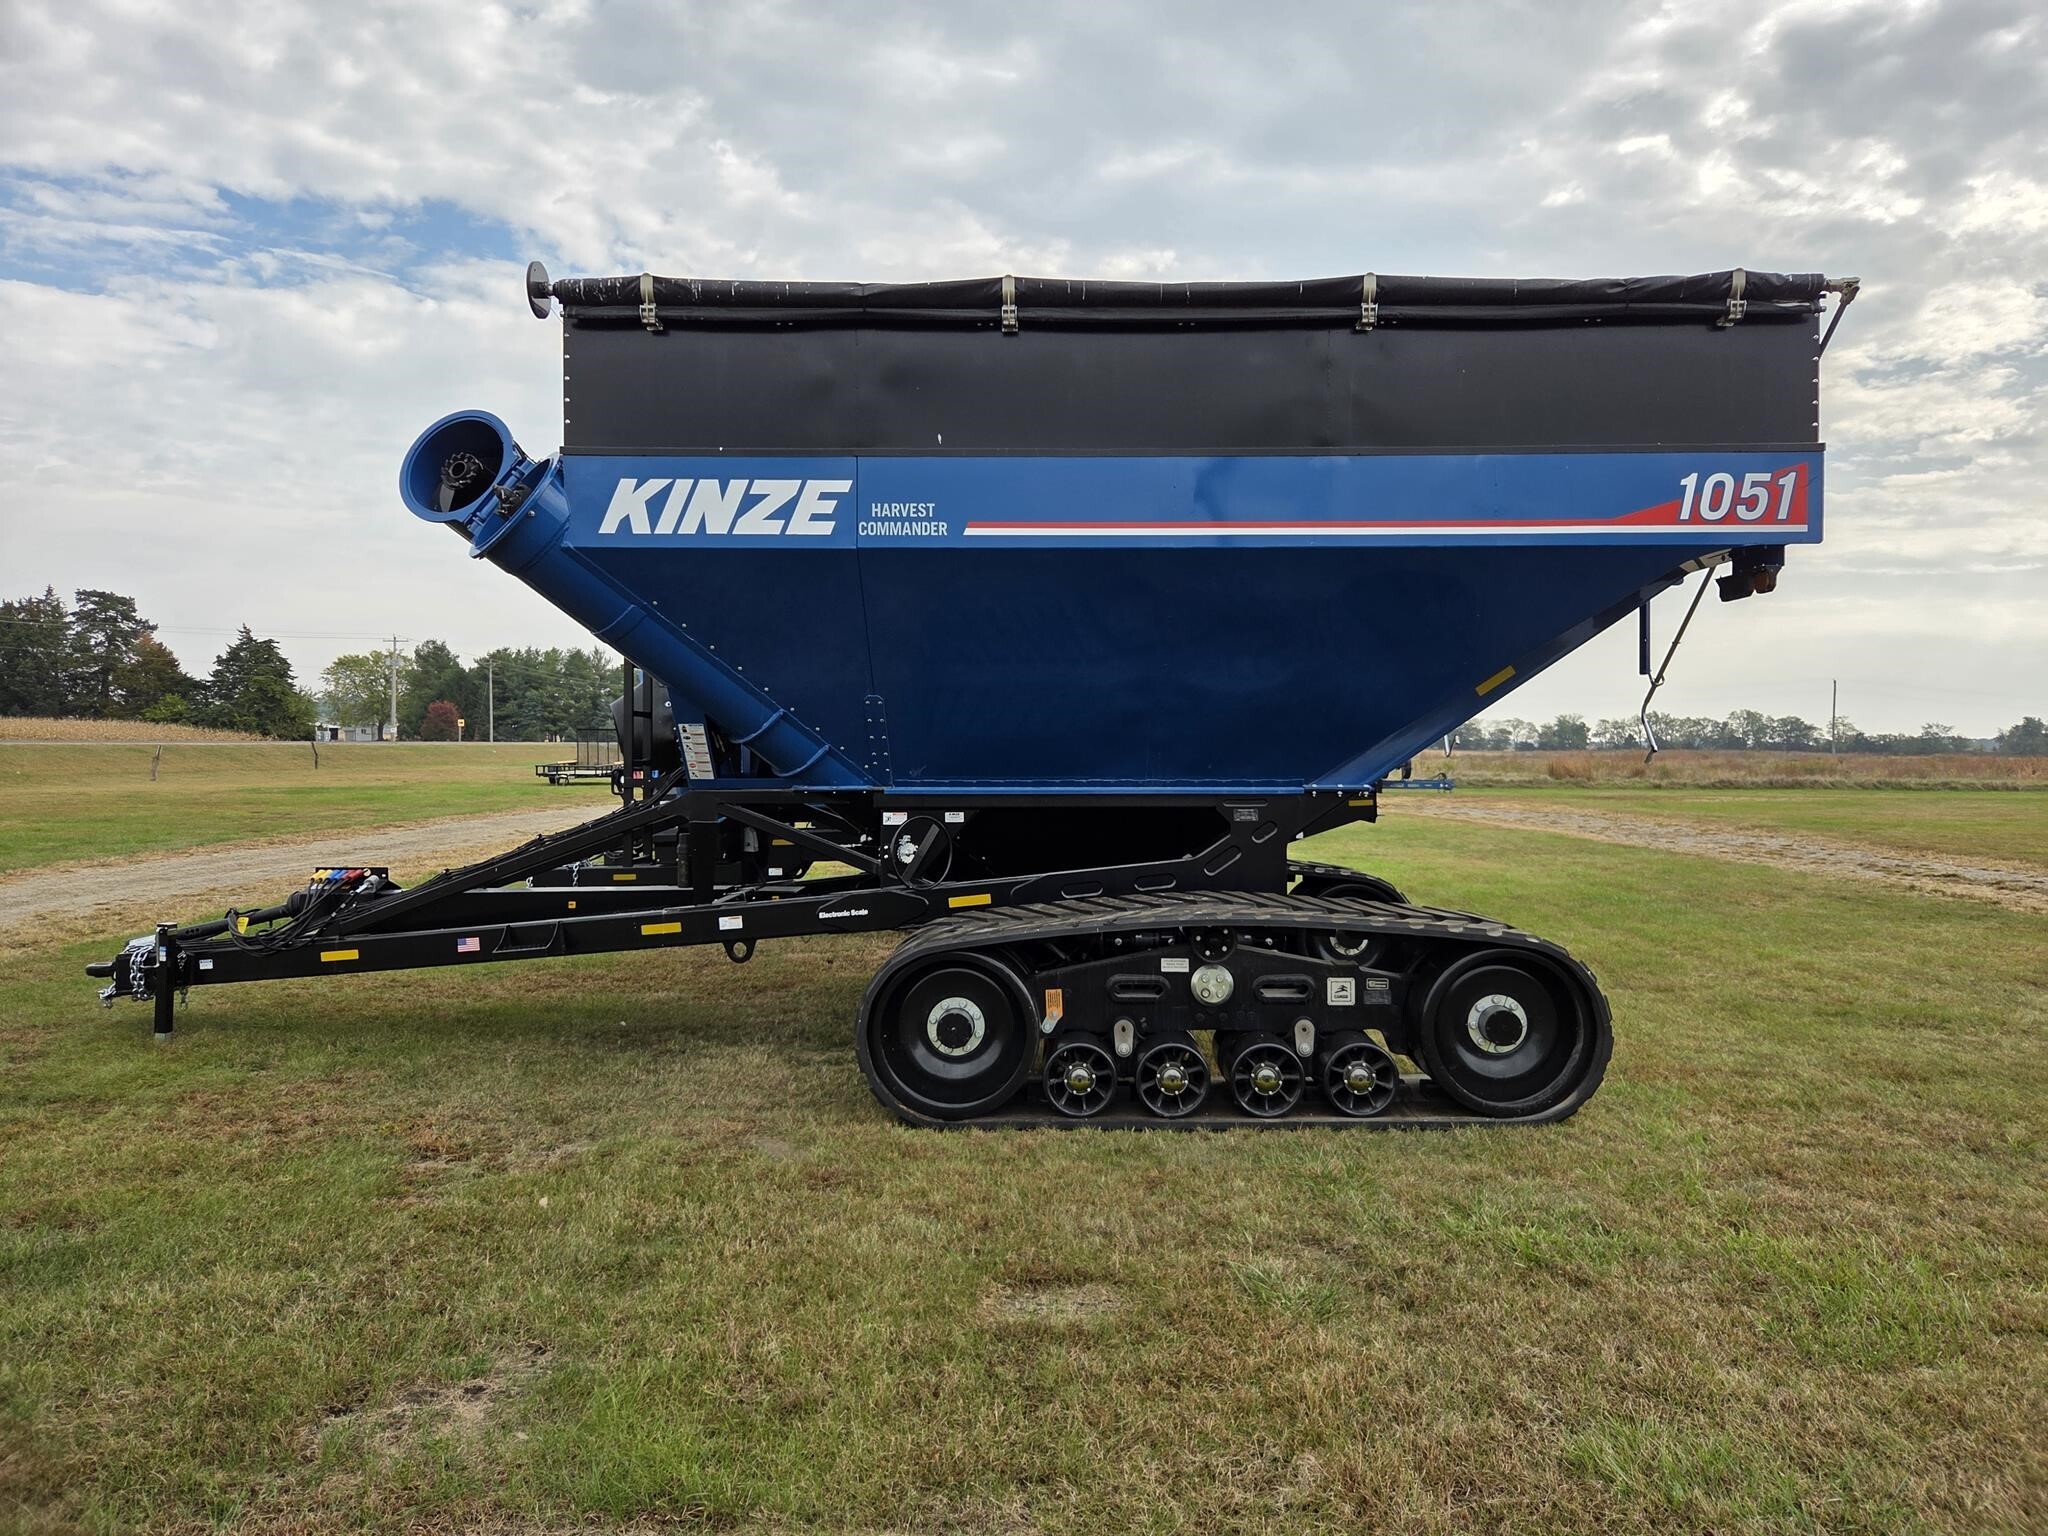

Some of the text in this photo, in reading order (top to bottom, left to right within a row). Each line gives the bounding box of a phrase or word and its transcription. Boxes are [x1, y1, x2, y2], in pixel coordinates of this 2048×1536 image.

[1679, 471, 1797, 521] 1051
[598, 478, 853, 535] KINZE
[871, 502, 935, 518] HARVEST
[858, 521, 948, 536] COMMANDER
[818, 908, 869, 919] Electronic Scale
